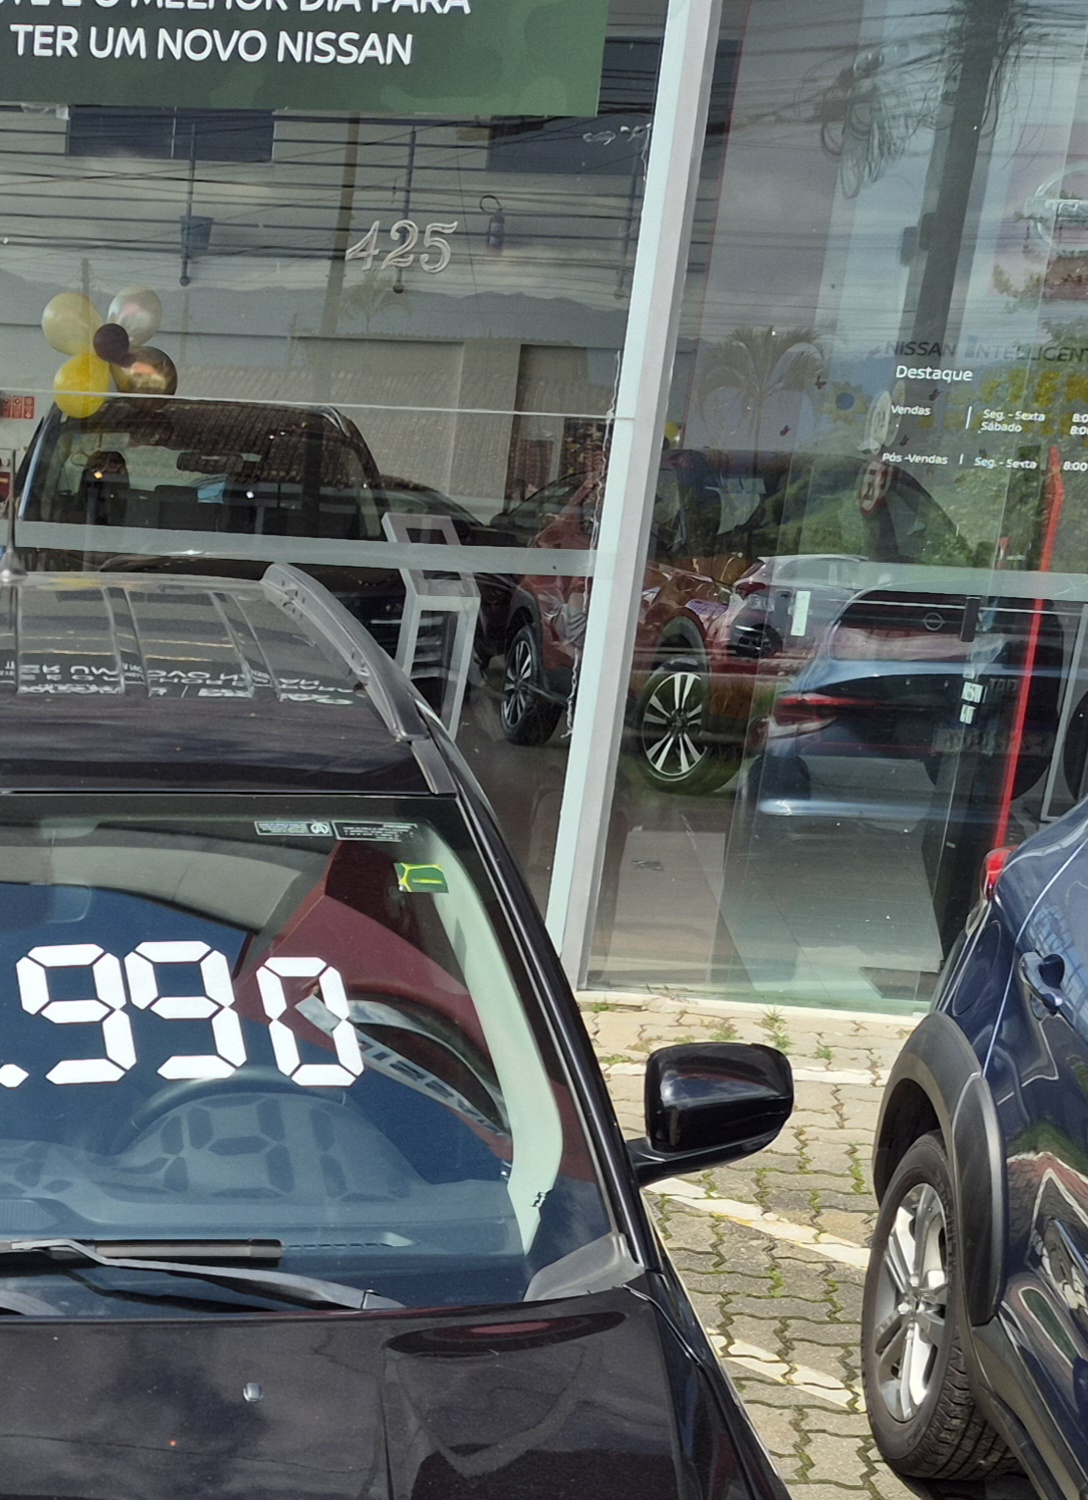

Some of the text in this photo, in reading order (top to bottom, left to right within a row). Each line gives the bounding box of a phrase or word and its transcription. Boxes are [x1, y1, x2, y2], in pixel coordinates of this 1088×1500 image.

[10, 24, 413, 65] TER UM NOVO NISSAN
[344, 219, 459, 274] 425
[885, 341, 957, 358] NISSAN
[895, 364, 974, 383] Destaque
[890, 404, 932, 416] Vendas
[983, 408, 1006, 421] Seg.
[1015, 410, 1046, 422] Sexta
[981, 420, 1023, 433] Sábado
[882, 451, 903, 463] Pós
[974, 456, 998, 470] Seg.
[1006, 458, 1038, 470] Sexta
